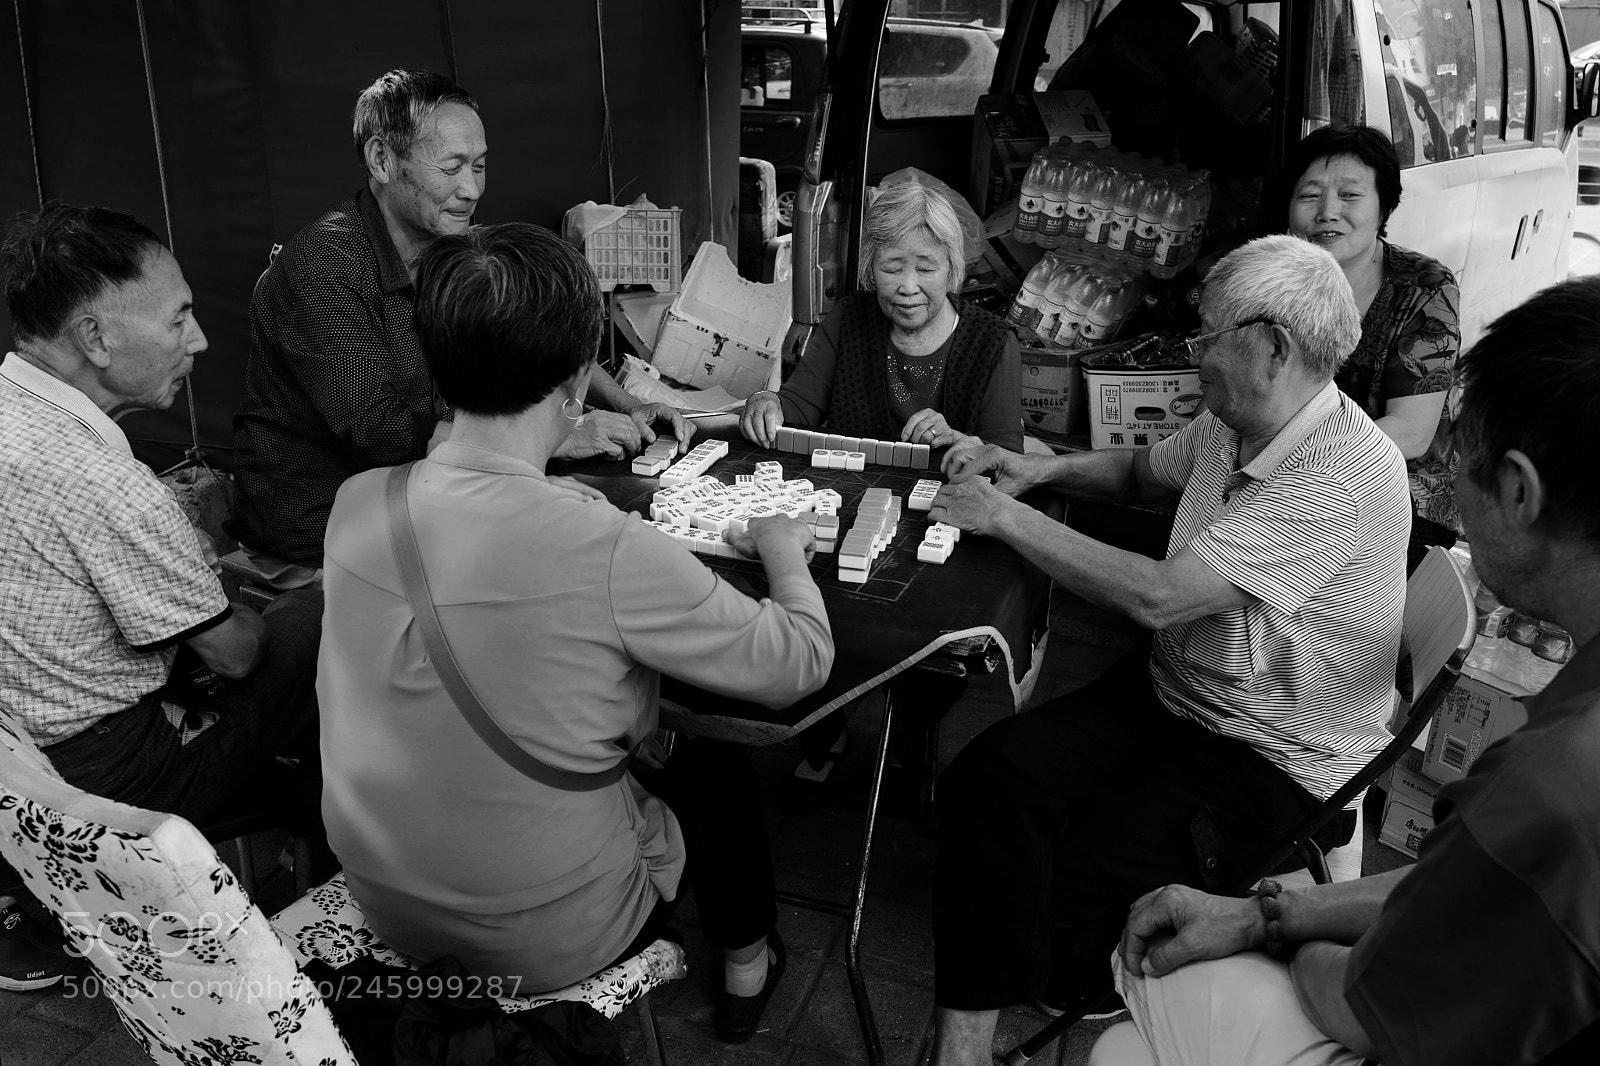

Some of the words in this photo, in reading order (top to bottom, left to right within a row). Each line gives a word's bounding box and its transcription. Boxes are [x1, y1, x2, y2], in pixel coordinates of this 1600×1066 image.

[1105, 389, 1119, 421] 精品
[1142, 422, 1152, 430] AT
[1153, 422, 1180, 430] STORE
